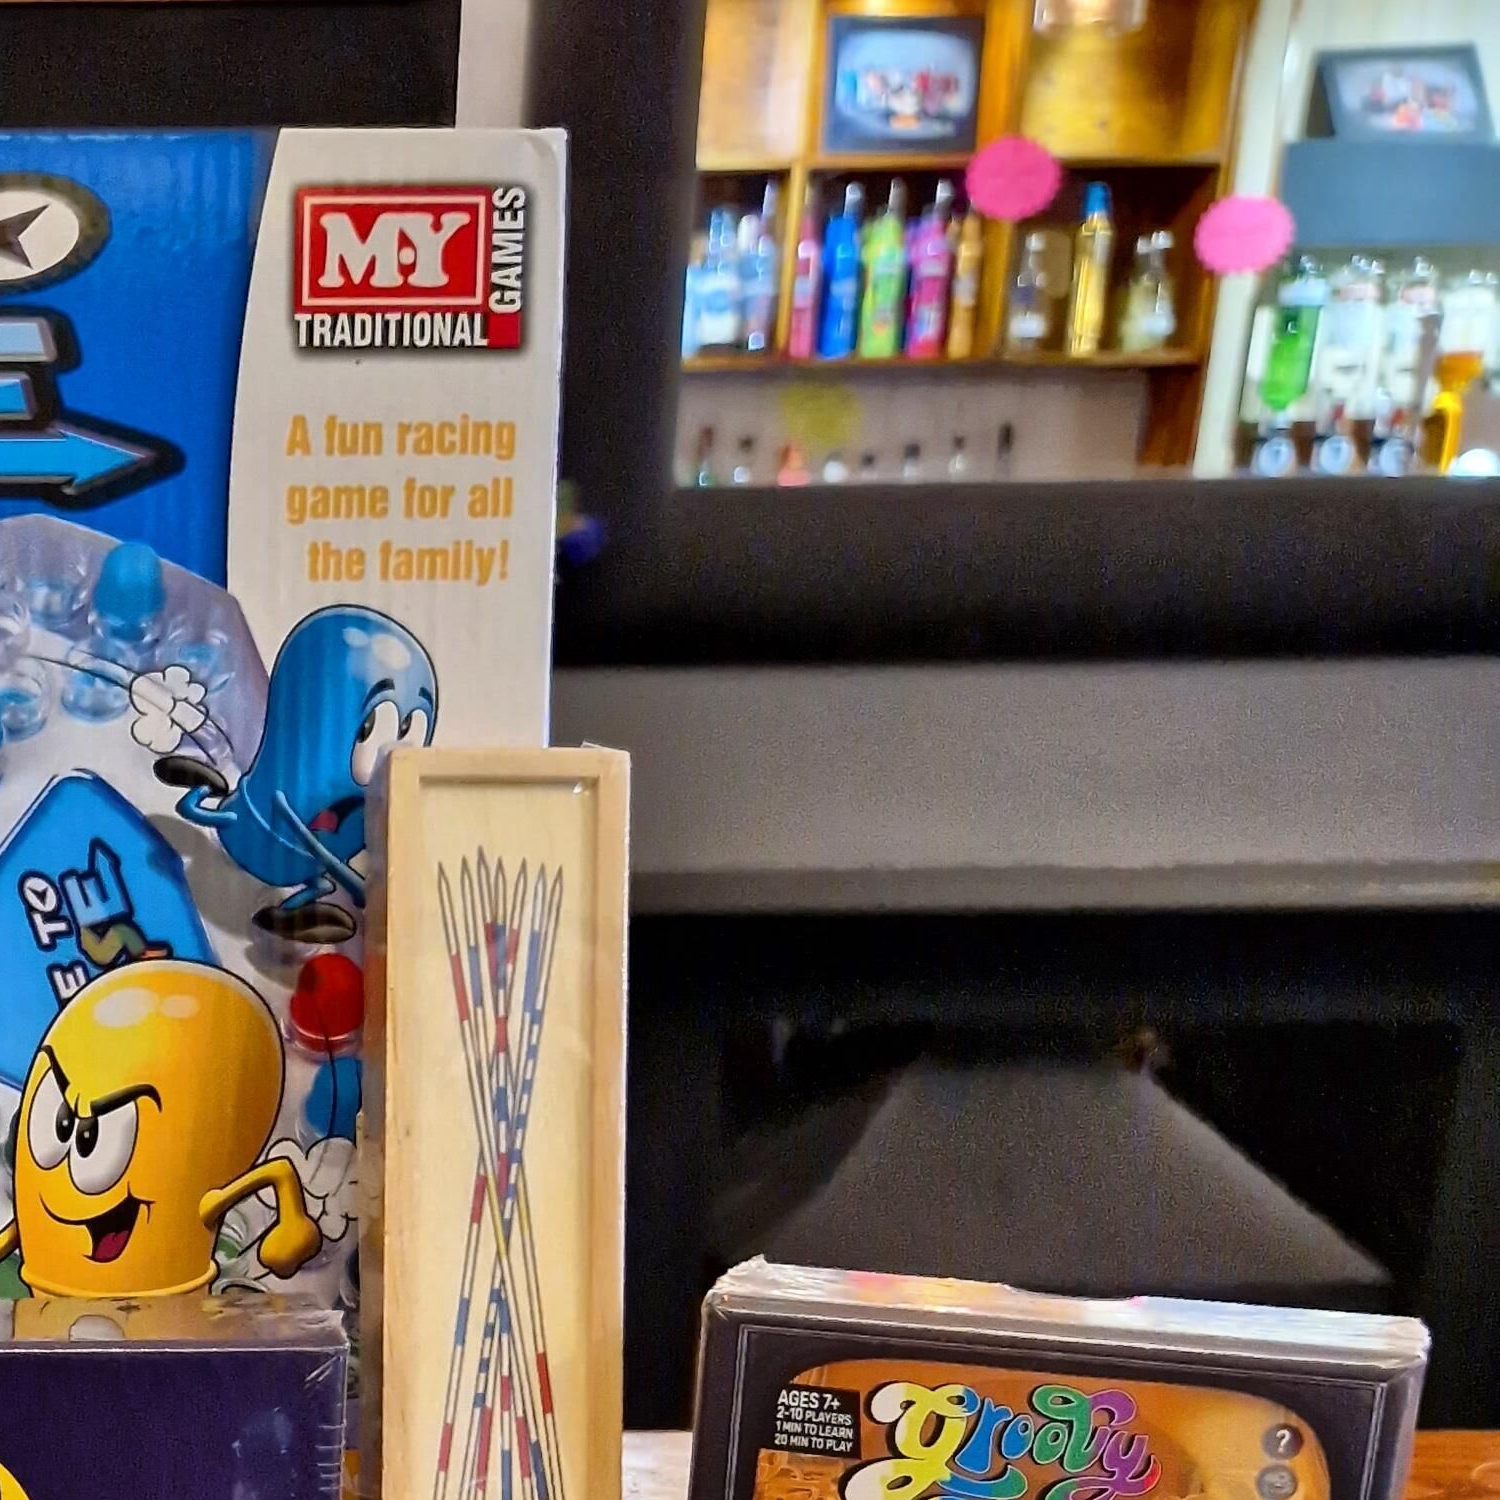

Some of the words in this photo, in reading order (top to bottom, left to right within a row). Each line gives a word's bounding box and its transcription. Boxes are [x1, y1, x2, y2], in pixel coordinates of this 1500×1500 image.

[488, 186, 526, 314] GAMES
[294, 312, 489, 348] TRADITIONAL
[285, 414, 312, 456] A
[323, 414, 384, 456] fun
[396, 413, 517, 461] racing
[286, 484, 390, 526] game
[403, 476, 456, 519] for
[467, 476, 513, 519] all
[307, 540, 366, 582] the
[378, 539, 510, 587] family!
[776, 1405, 803, 1421] 2-10
[804, 1410, 853, 1426] PLAYERS
[777, 1388, 820, 1409] AGES
[822, 1392, 841, 1411] 7+
[774, 1432, 788, 1446] 20
[789, 1434, 809, 1448] MIN
[810, 1436, 824, 1449] TO
[825, 1438, 853, 1453] PLAY
[782, 1421, 802, 1433] MIN
[803, 1422, 817, 1436] TO
[819, 1424, 854, 1440] LEARN
